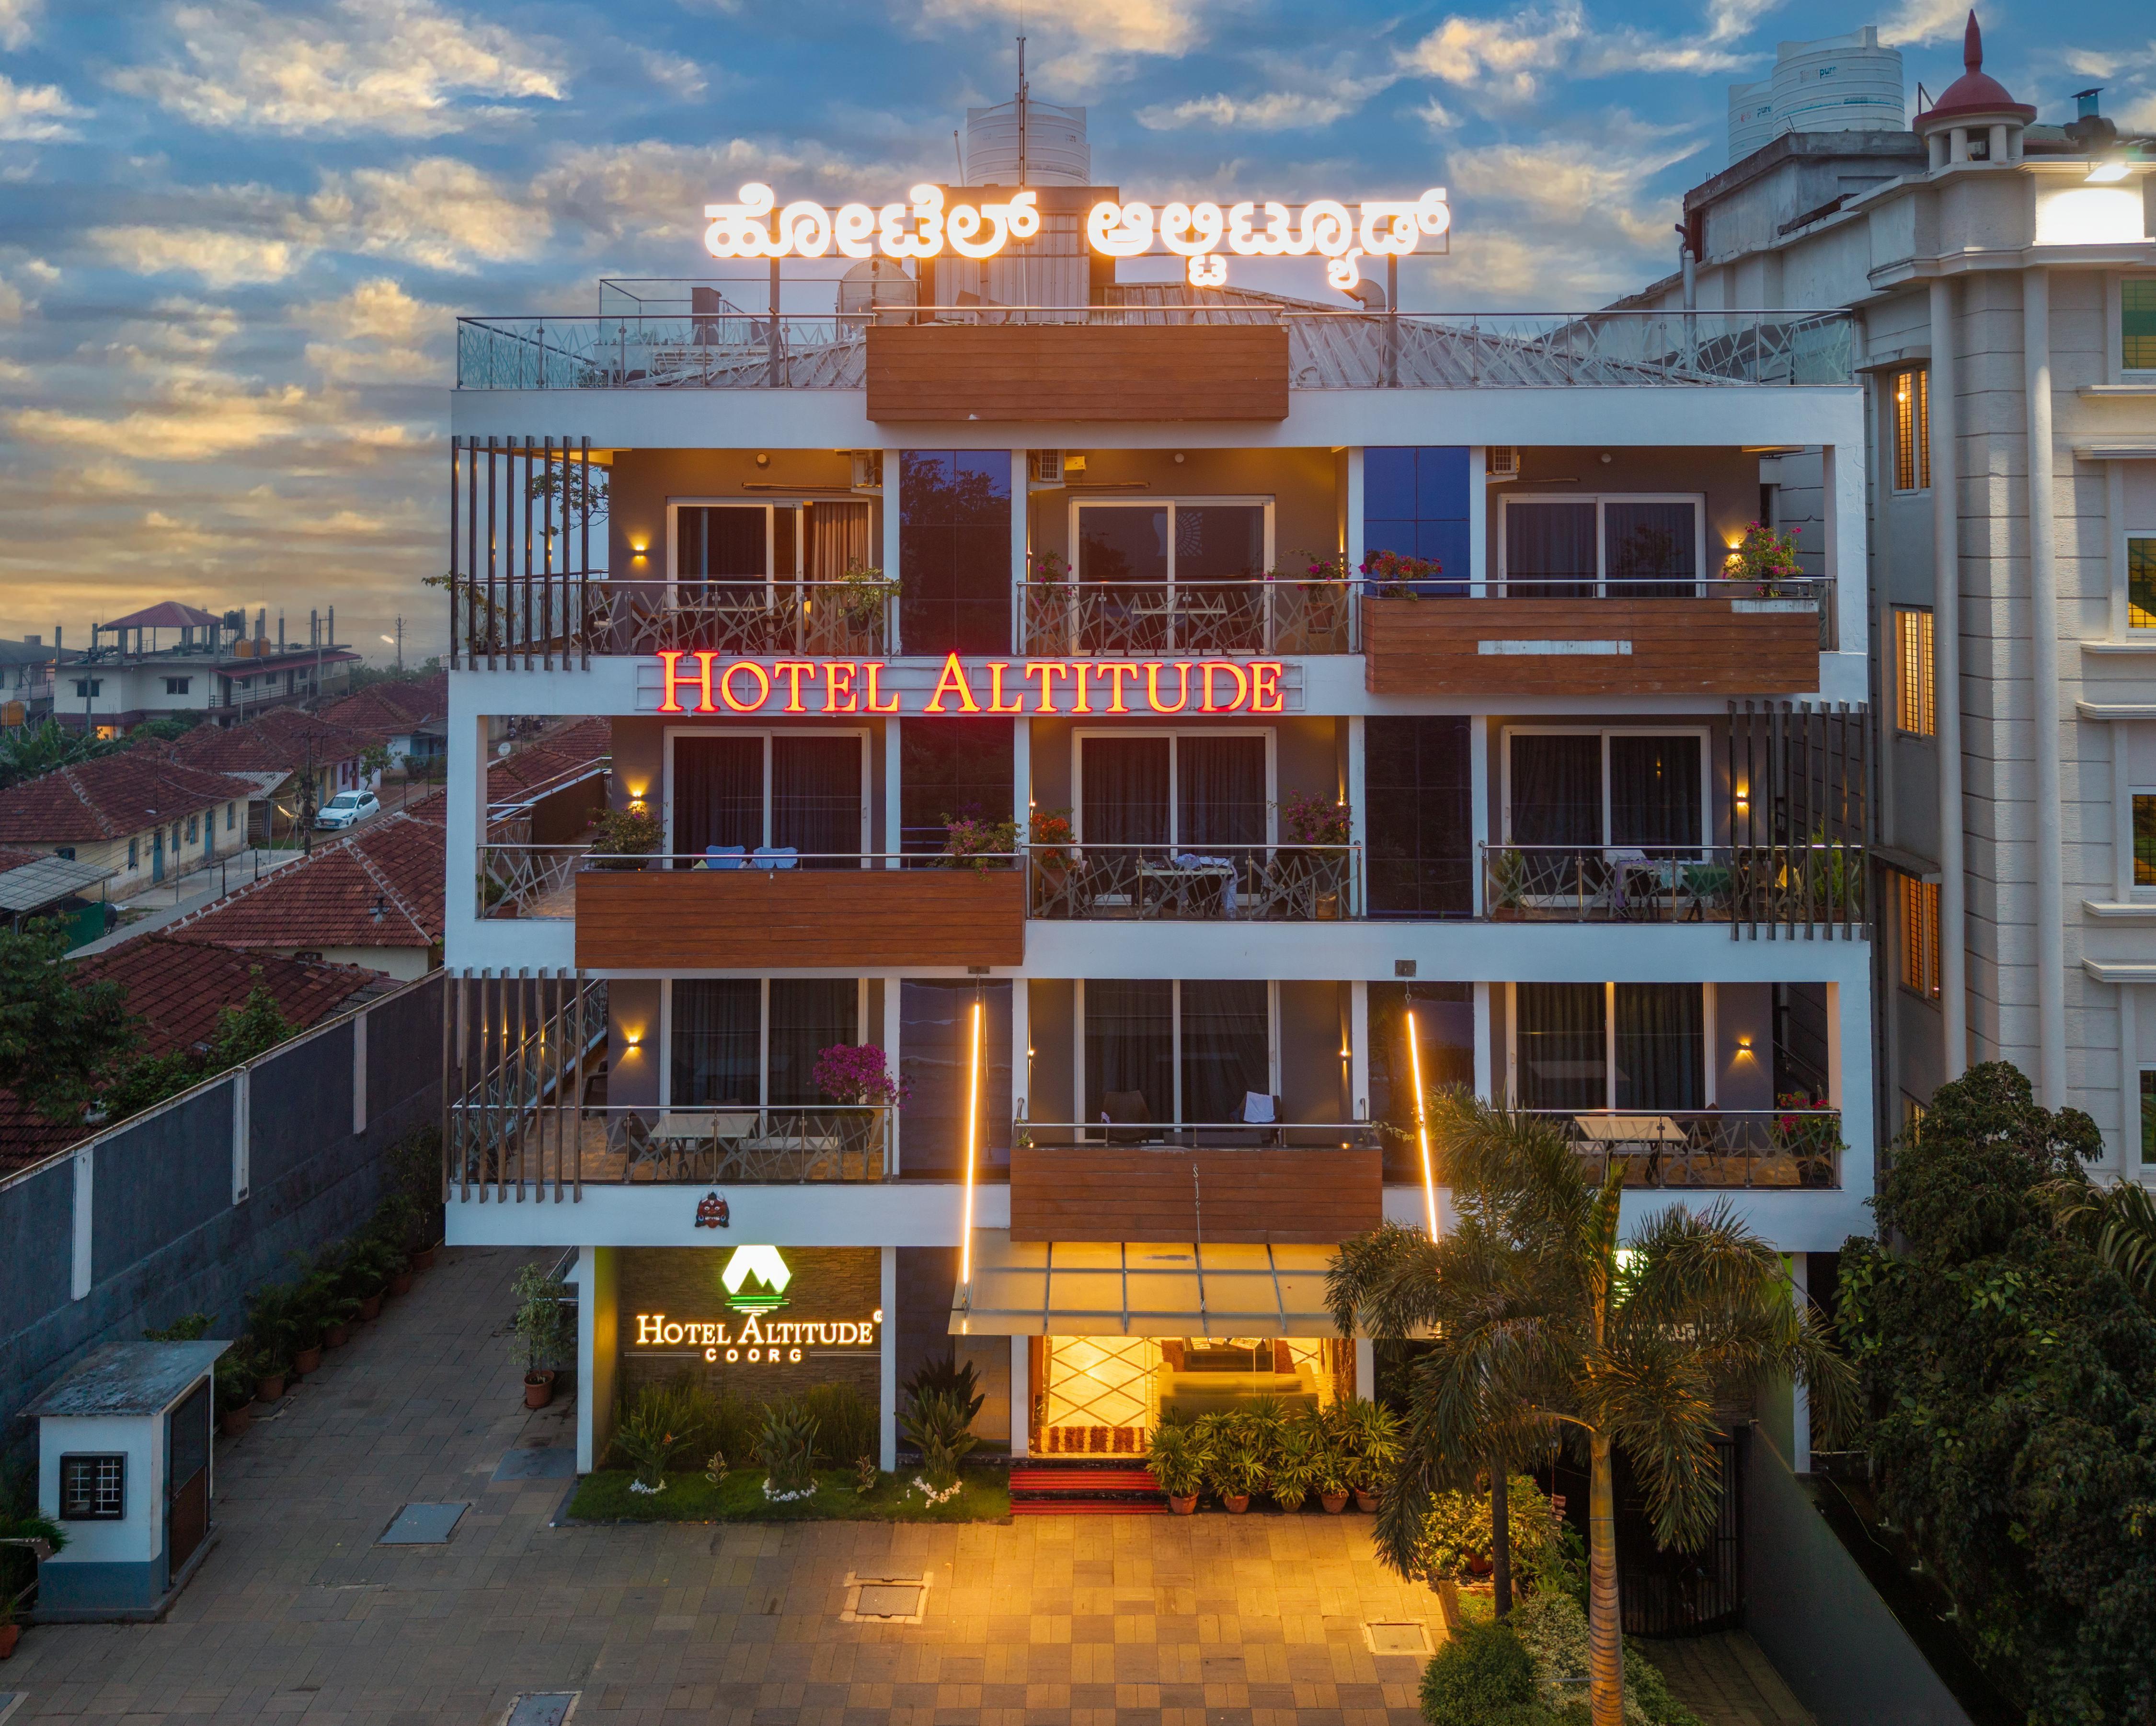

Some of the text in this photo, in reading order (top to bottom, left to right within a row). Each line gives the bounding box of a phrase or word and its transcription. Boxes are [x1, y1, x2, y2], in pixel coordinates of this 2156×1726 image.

[704, 183, 1040, 259] ಹೋಟೆಲ್
[656, 650, 1284, 713] HOTEL ALTITUDE
[636, 1315, 731, 1345] HOTEL
[737, 1315, 873, 1345] ALTITUDE
[705, 1348, 802, 1362] COORG
